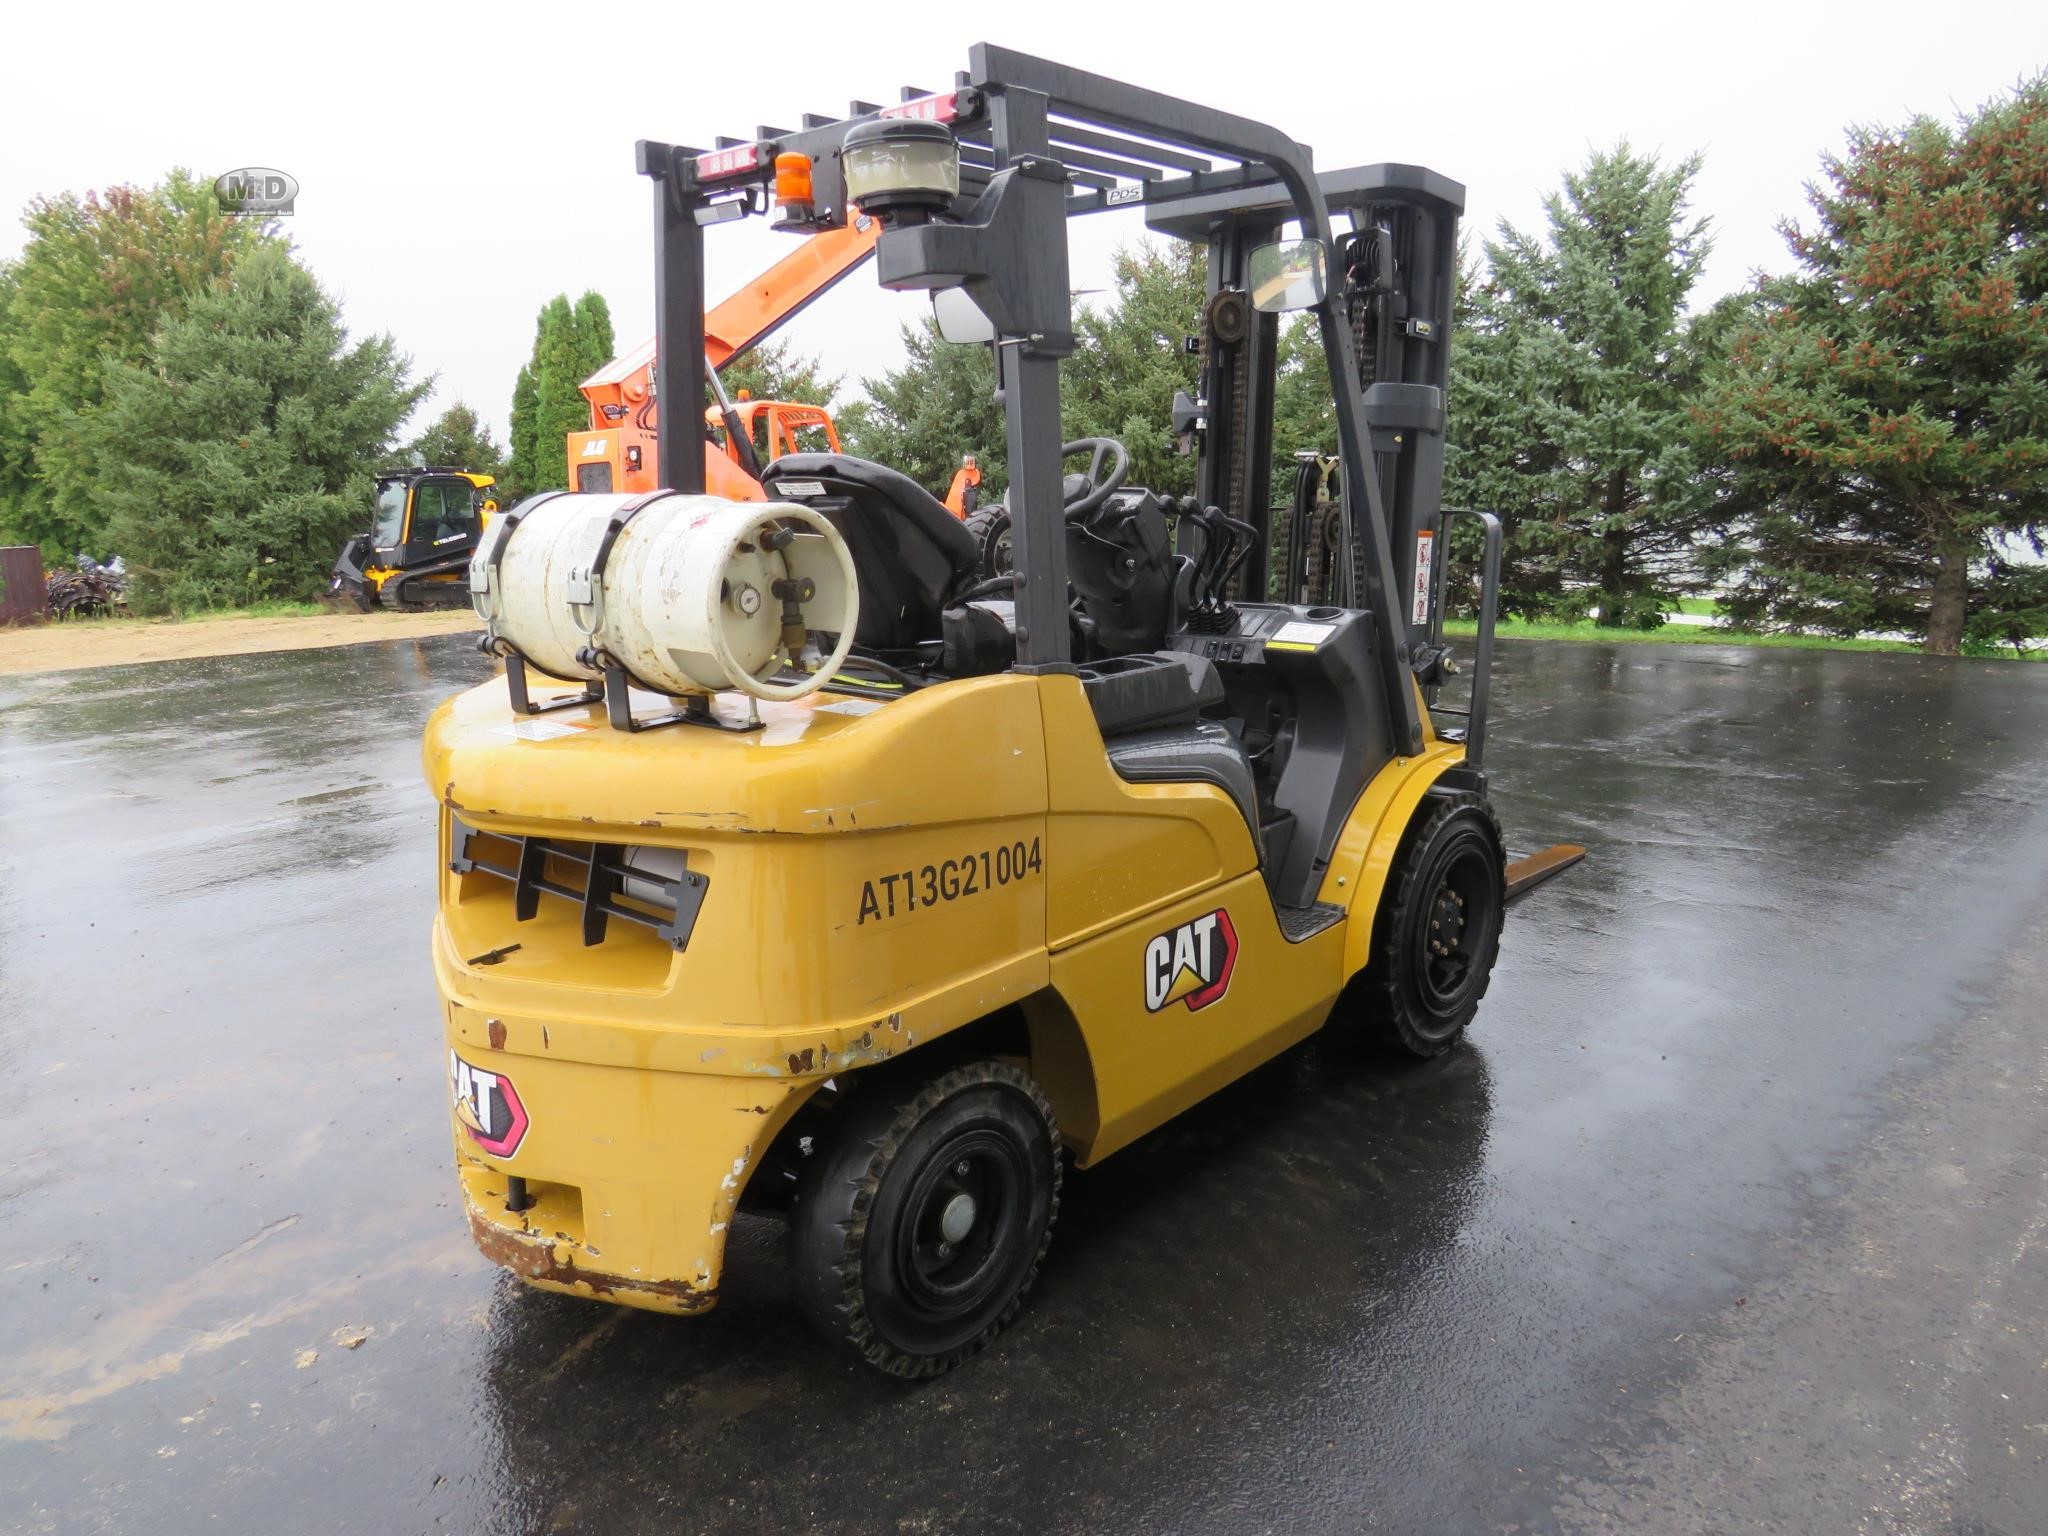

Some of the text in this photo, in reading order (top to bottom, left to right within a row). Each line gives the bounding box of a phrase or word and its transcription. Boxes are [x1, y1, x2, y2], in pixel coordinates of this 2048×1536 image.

[1110, 187, 1139, 201] PDS
[857, 836, 1042, 925] AT13G21004
[1145, 912, 1217, 1011] CAT
